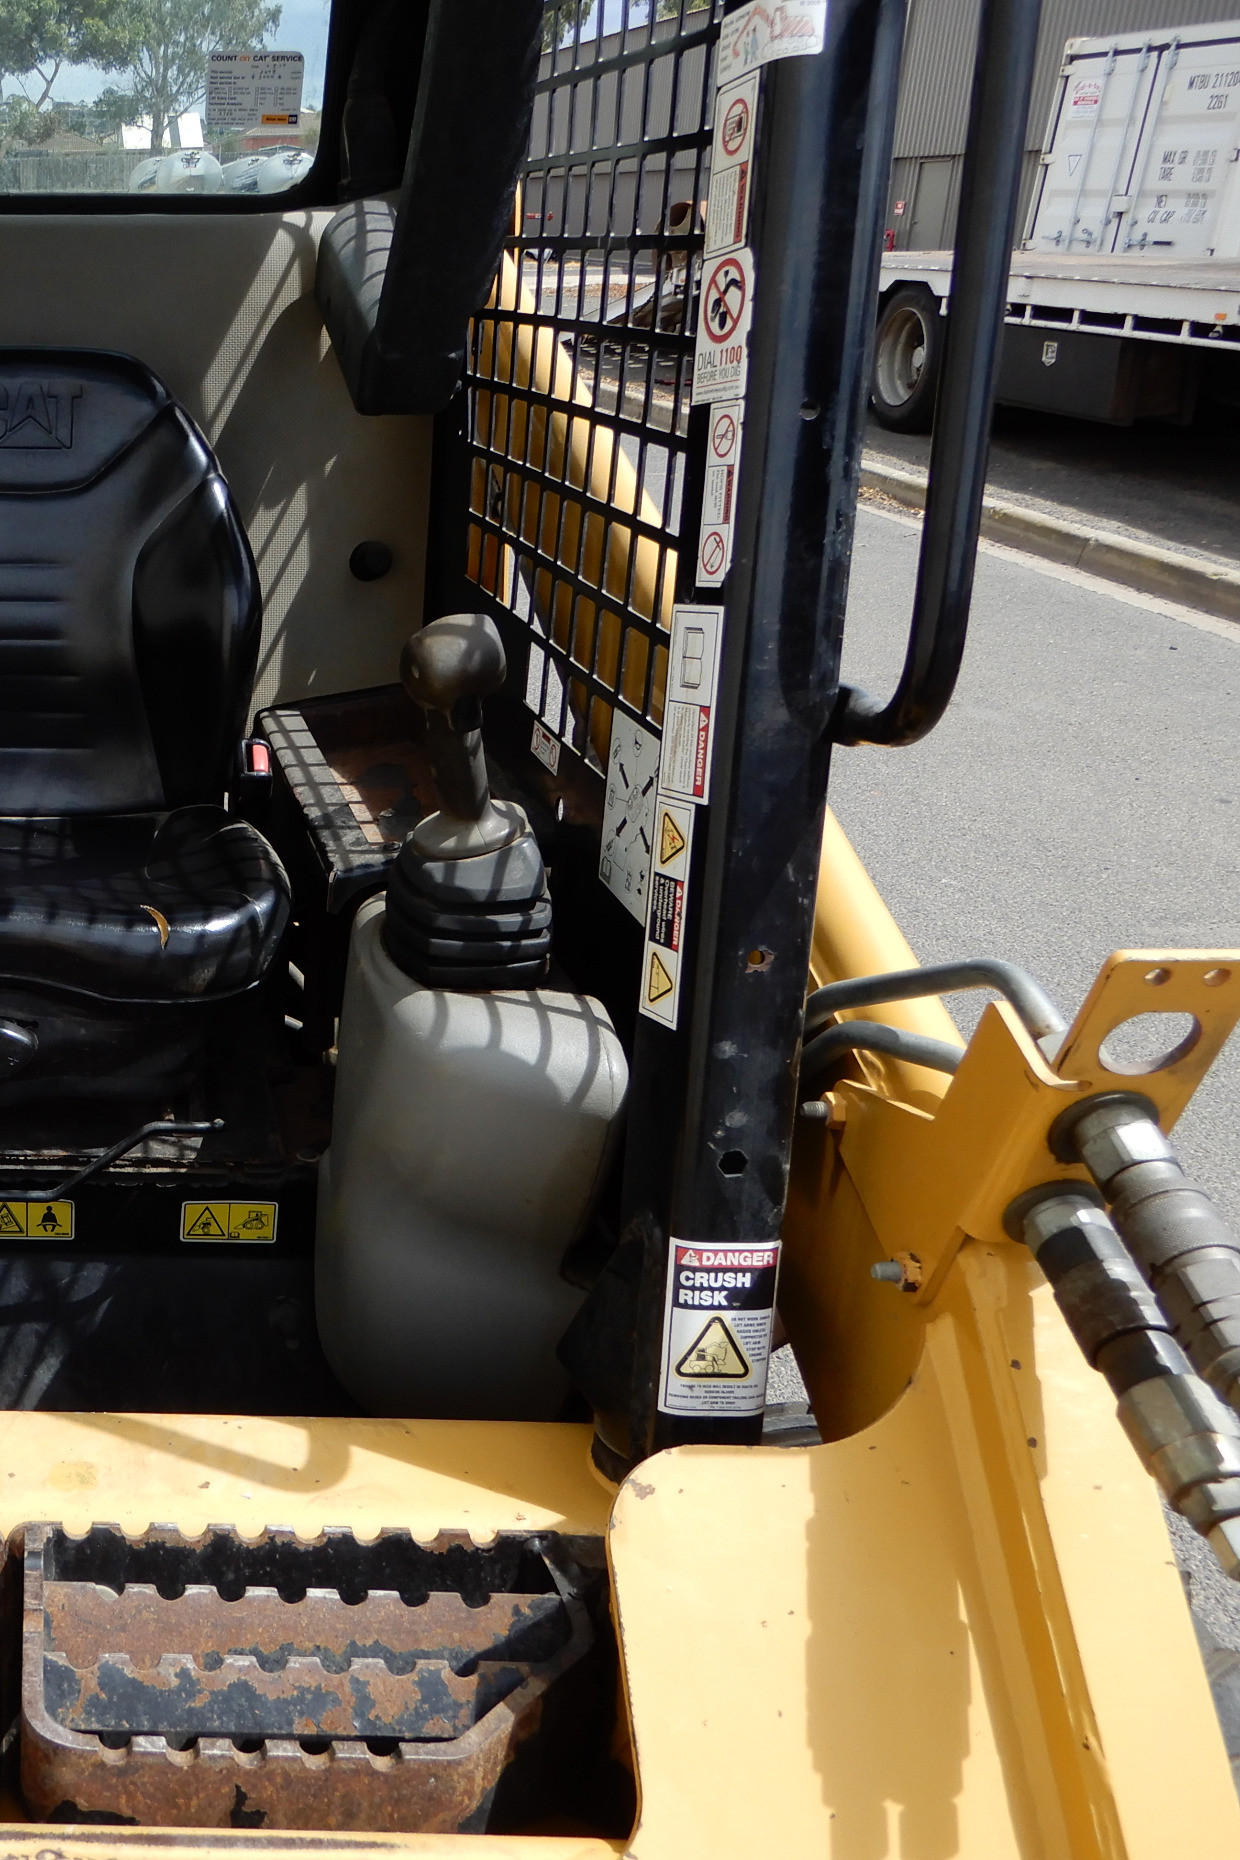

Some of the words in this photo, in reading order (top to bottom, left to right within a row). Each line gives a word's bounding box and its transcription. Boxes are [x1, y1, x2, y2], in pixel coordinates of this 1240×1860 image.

[1187, 74, 1211, 90] MTBU
[1212, 70, 1240, 89] 21120
[697, 350, 717, 371] DIAL
[720, 345, 742, 366] 1100
[697, 370, 717, 384] BEFORE
[719, 367, 730, 379] YOU
[730, 365, 740, 377] DIG
[695, 731, 706, 786] DANGER
[655, 885, 664, 940] underground
[662, 880, 670, 920] Overhead
[667, 881, 676, 920] BEWARE
[673, 900, 682, 945] DANGER
[702, 1252, 773, 1266] DANGER
[679, 1271, 751, 1288] CRUSH
[678, 1289, 728, 1306] RISK
